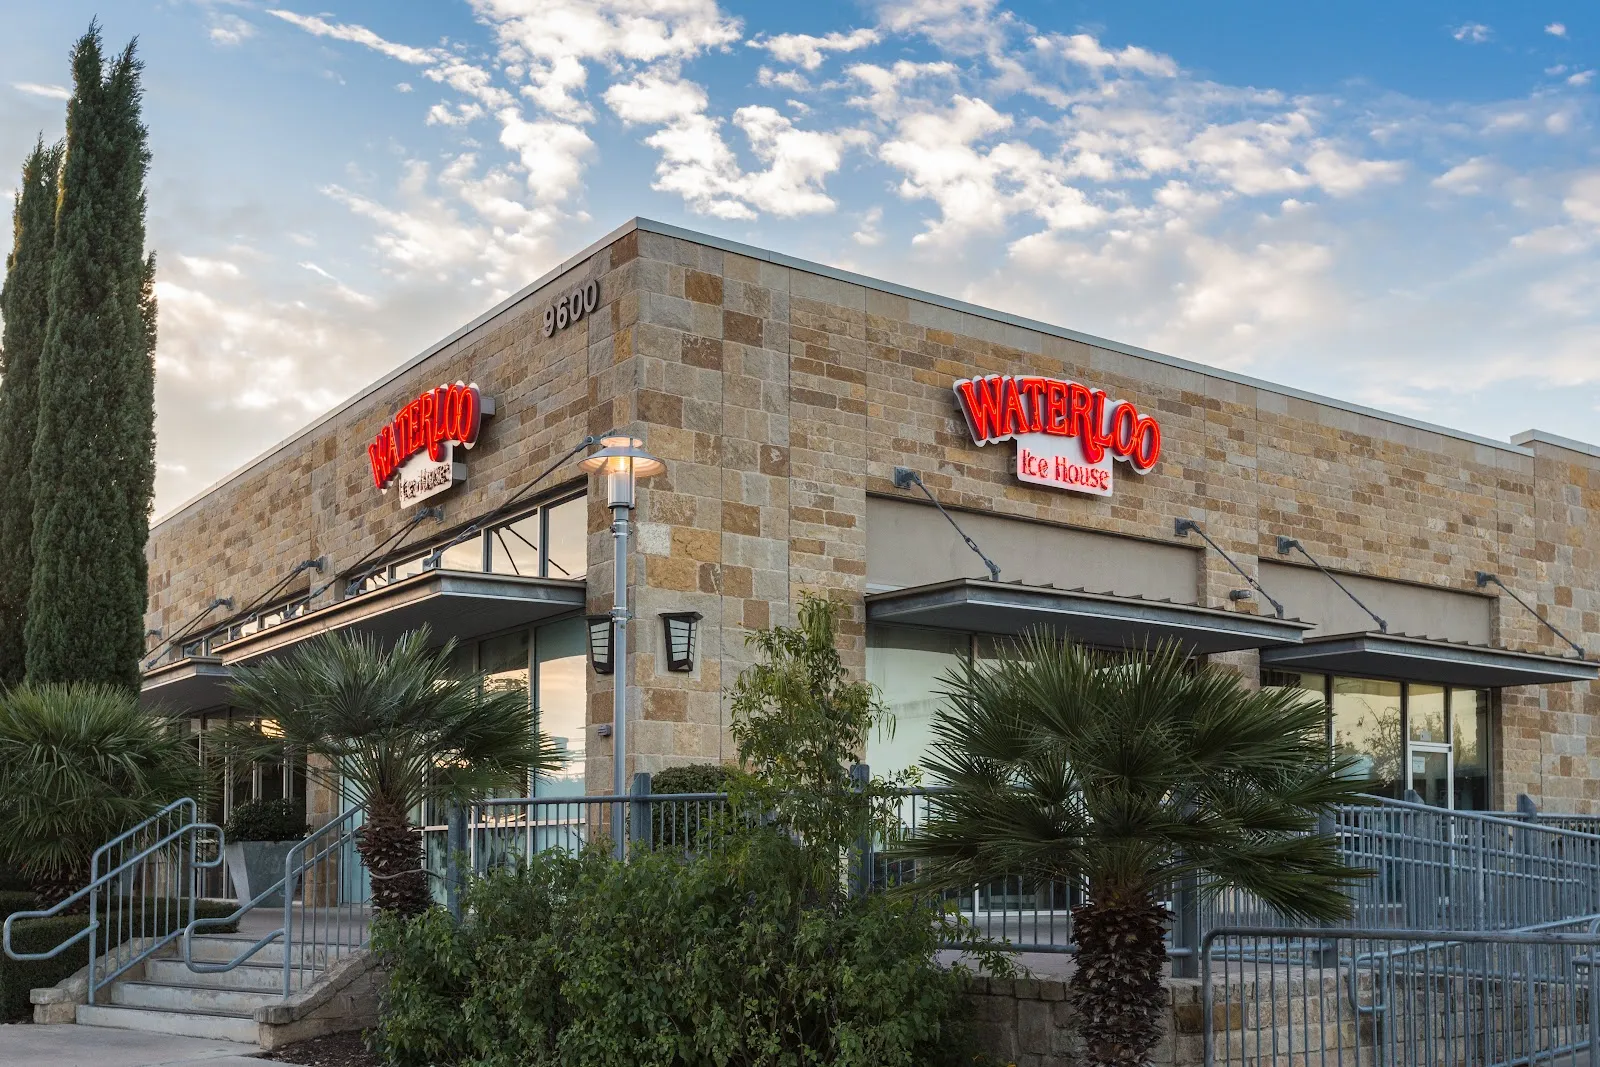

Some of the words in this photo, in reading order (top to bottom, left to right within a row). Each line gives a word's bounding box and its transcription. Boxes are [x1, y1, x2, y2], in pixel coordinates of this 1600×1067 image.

[543, 279, 599, 338] 9600
[368, 383, 480, 489] WATERLOO
[957, 376, 1161, 469] WATERLOO
[1020, 449, 1049, 478] Ice
[1054, 455, 1111, 490] House
